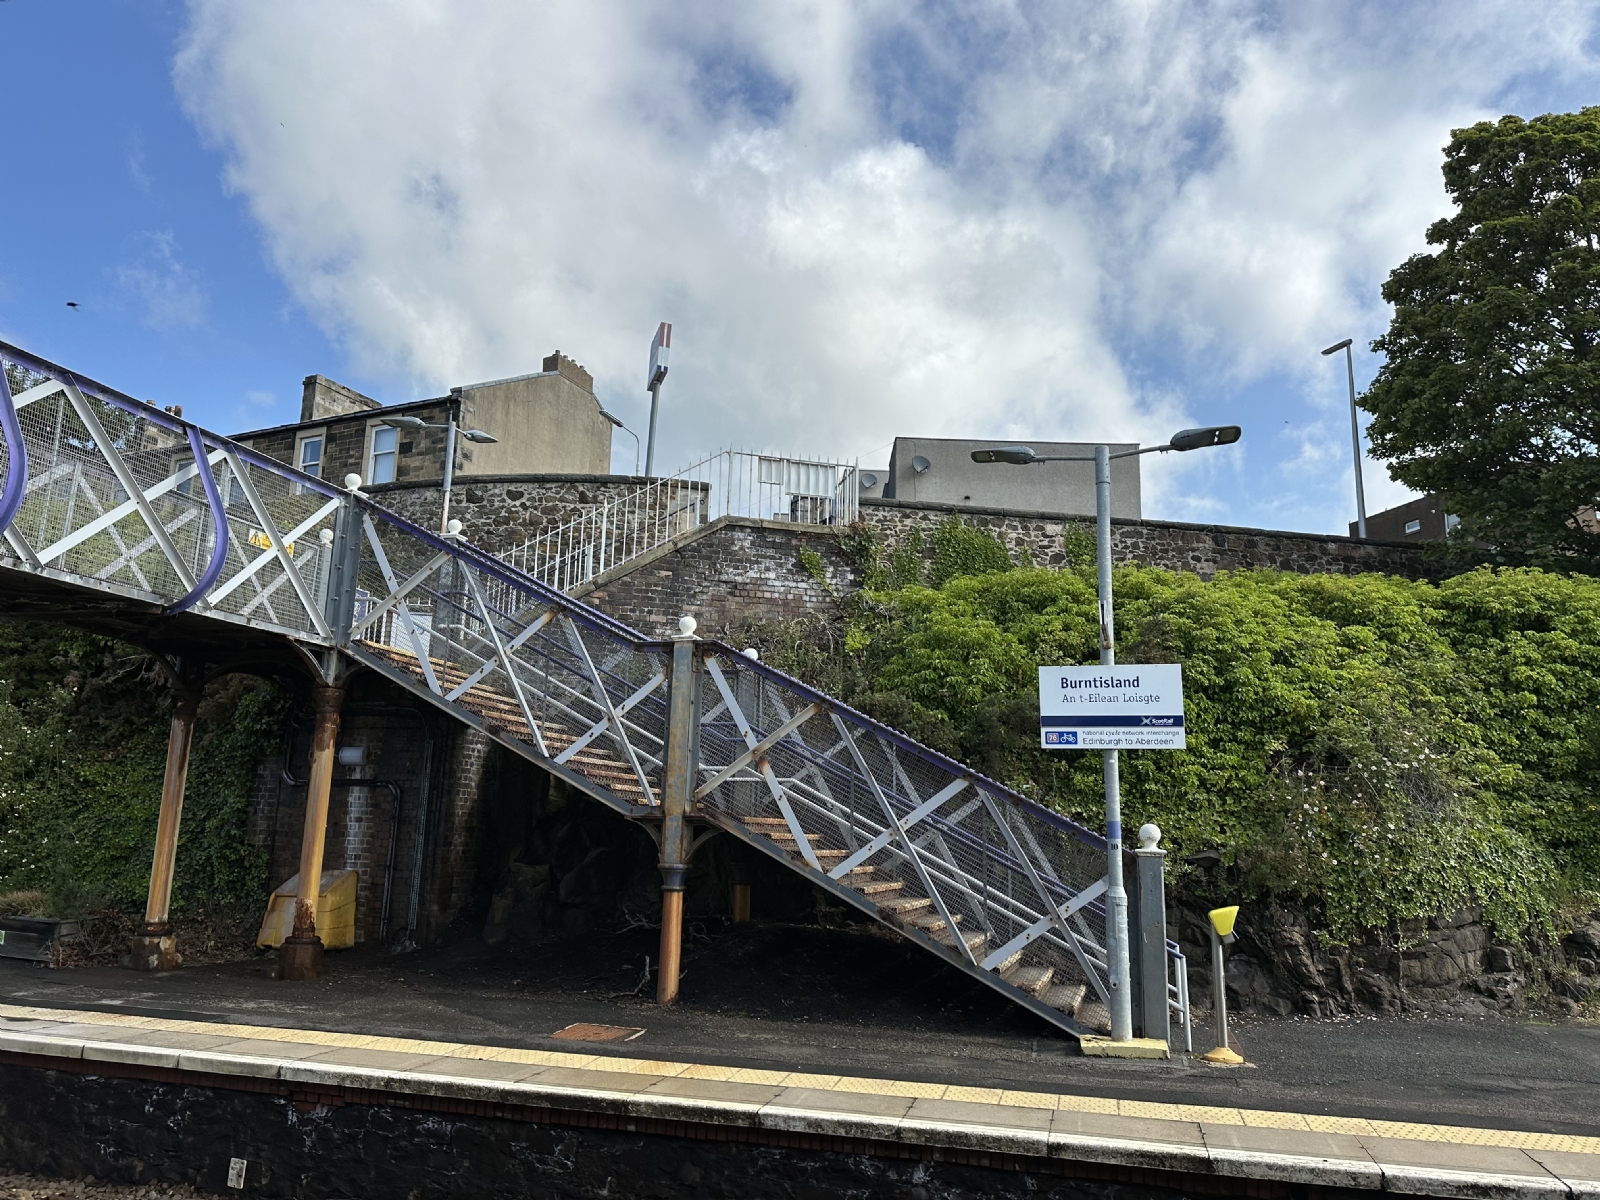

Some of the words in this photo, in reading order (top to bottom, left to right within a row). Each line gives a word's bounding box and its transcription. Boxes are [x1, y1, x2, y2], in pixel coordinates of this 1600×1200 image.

[1061, 676, 1140, 689] Burntisland
[1062, 694, 1076, 703] An
[1079, 693, 1119, 703] t-Eilean
[1123, 693, 1160, 704] Loisgte
[1082, 738, 1124, 746] Edinburgh
